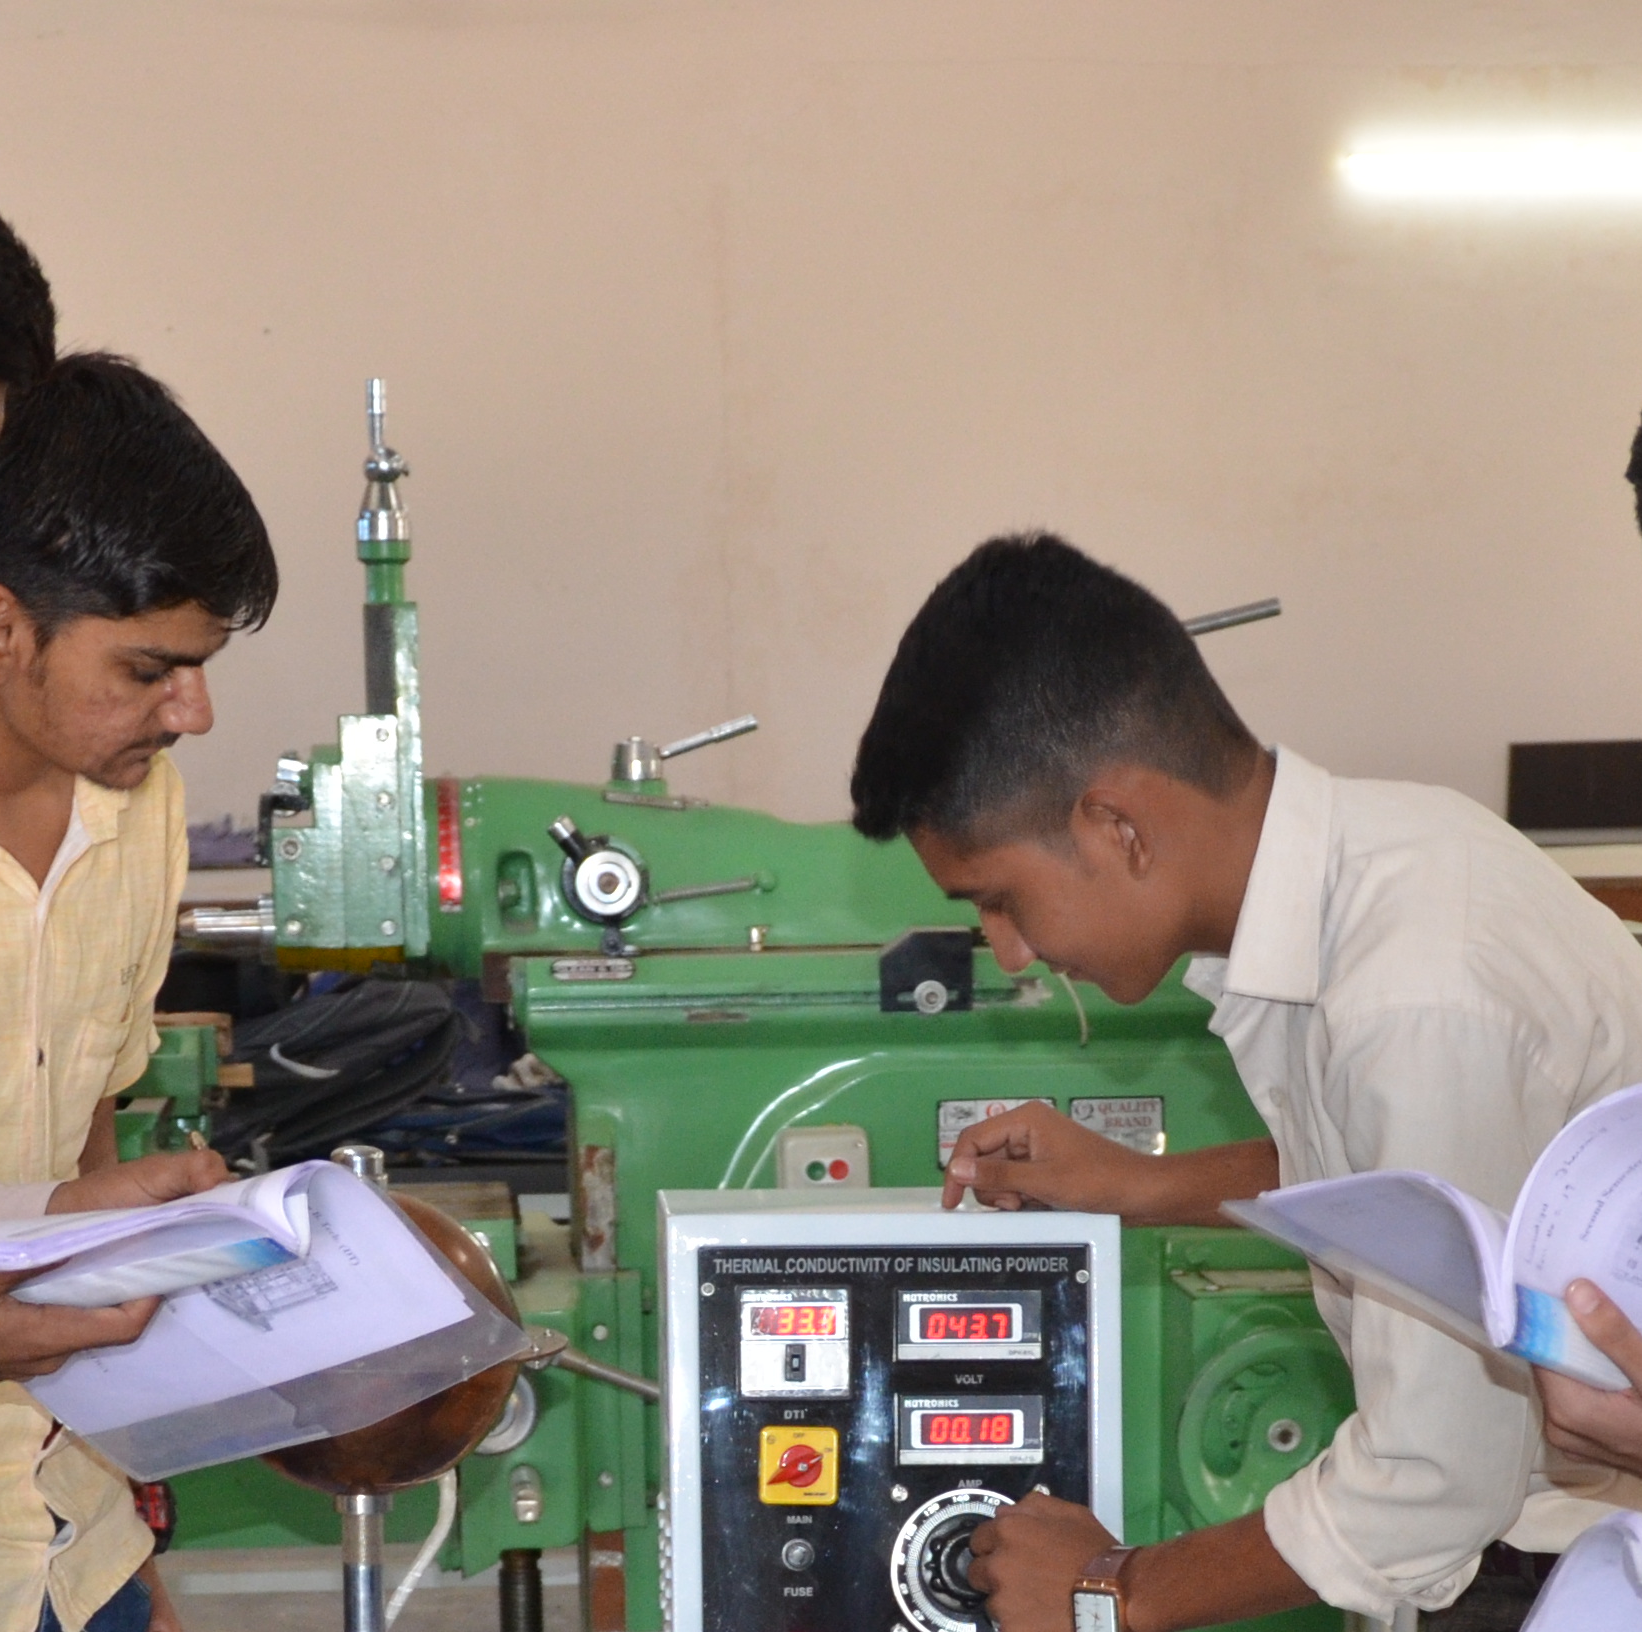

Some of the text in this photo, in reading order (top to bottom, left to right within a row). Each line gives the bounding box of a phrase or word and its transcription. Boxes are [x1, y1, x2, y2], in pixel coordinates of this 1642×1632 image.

[1098, 1101, 1157, 1114] QUALITY
[1104, 1117, 1152, 1128] BRAND
[713, 1257, 1069, 1274] THERMAL CONDUCTIVITY OF INSULATING POWDER
[955, 1374, 984, 1384] VOLT
[784, 1409, 805, 1420] DTI
[958, 1479, 983, 1488] AMP
[786, 1515, 813, 1524] MAIN
[784, 1587, 814, 1597] FUSE
